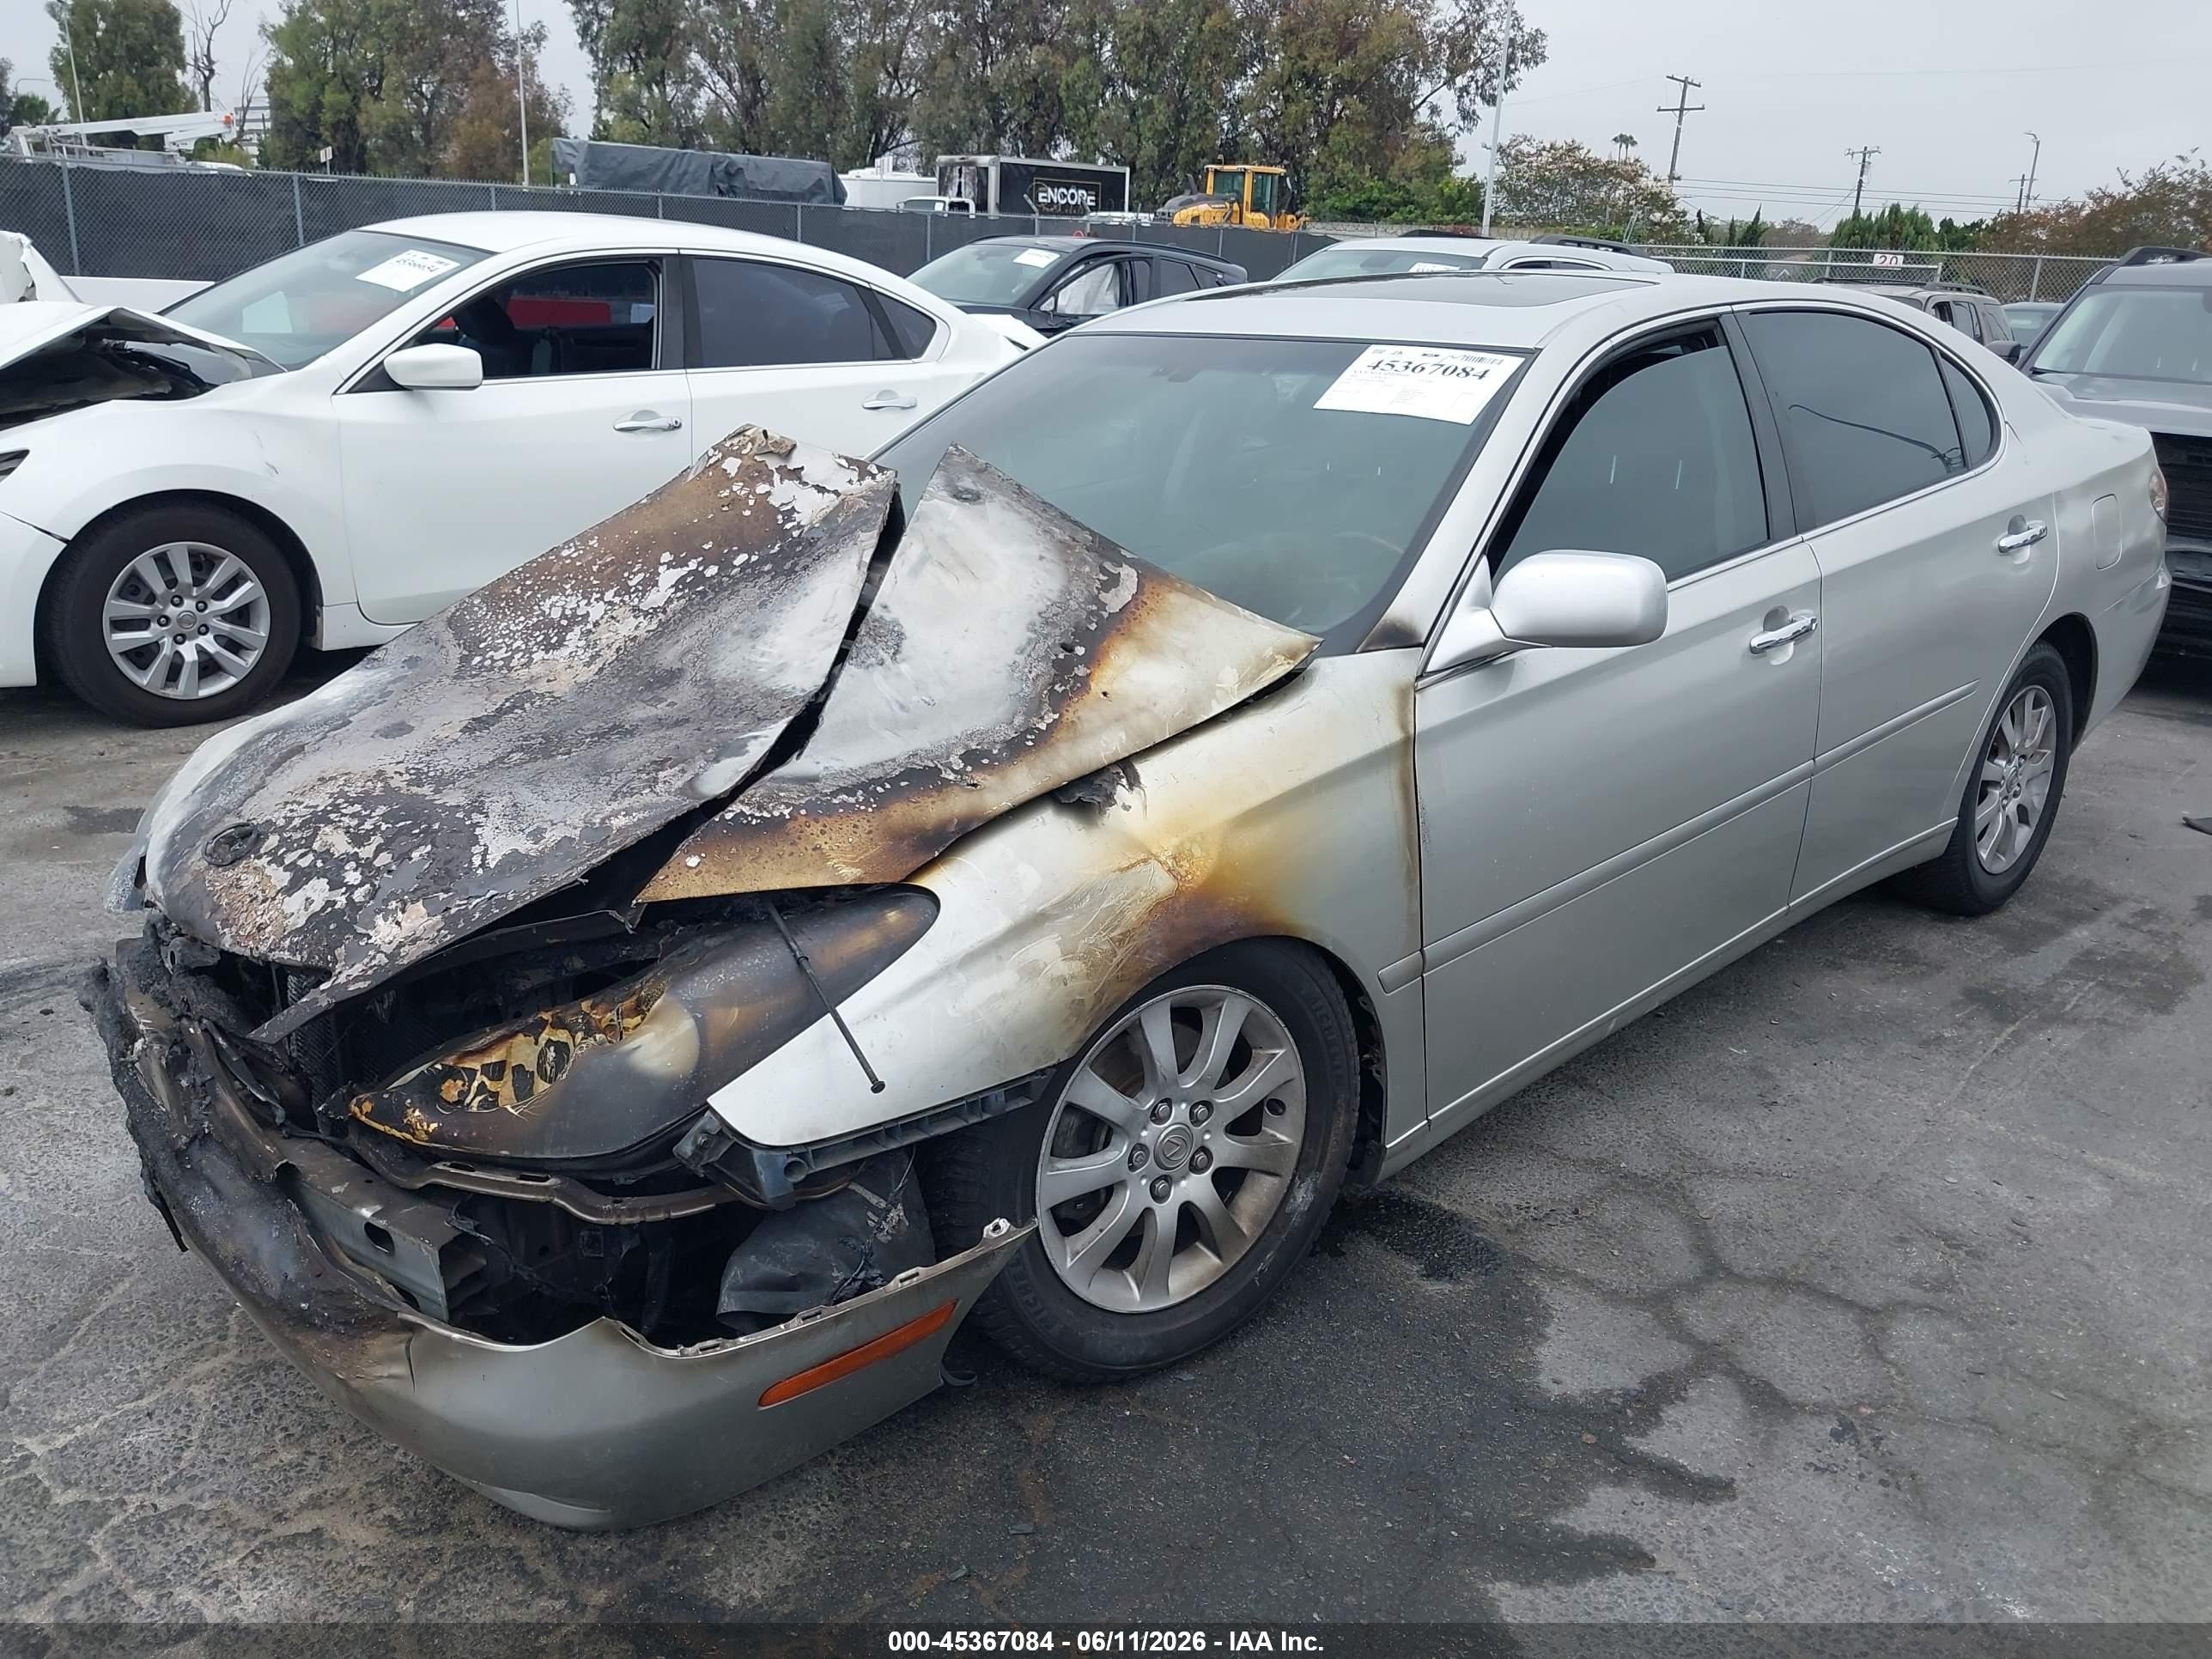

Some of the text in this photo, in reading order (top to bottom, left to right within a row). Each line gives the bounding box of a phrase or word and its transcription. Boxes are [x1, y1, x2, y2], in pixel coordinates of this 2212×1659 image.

[1038, 186, 1097, 207] ENCORE
[1879, 255, 1899, 265] 20
[1366, 359, 1491, 380] 45367084
